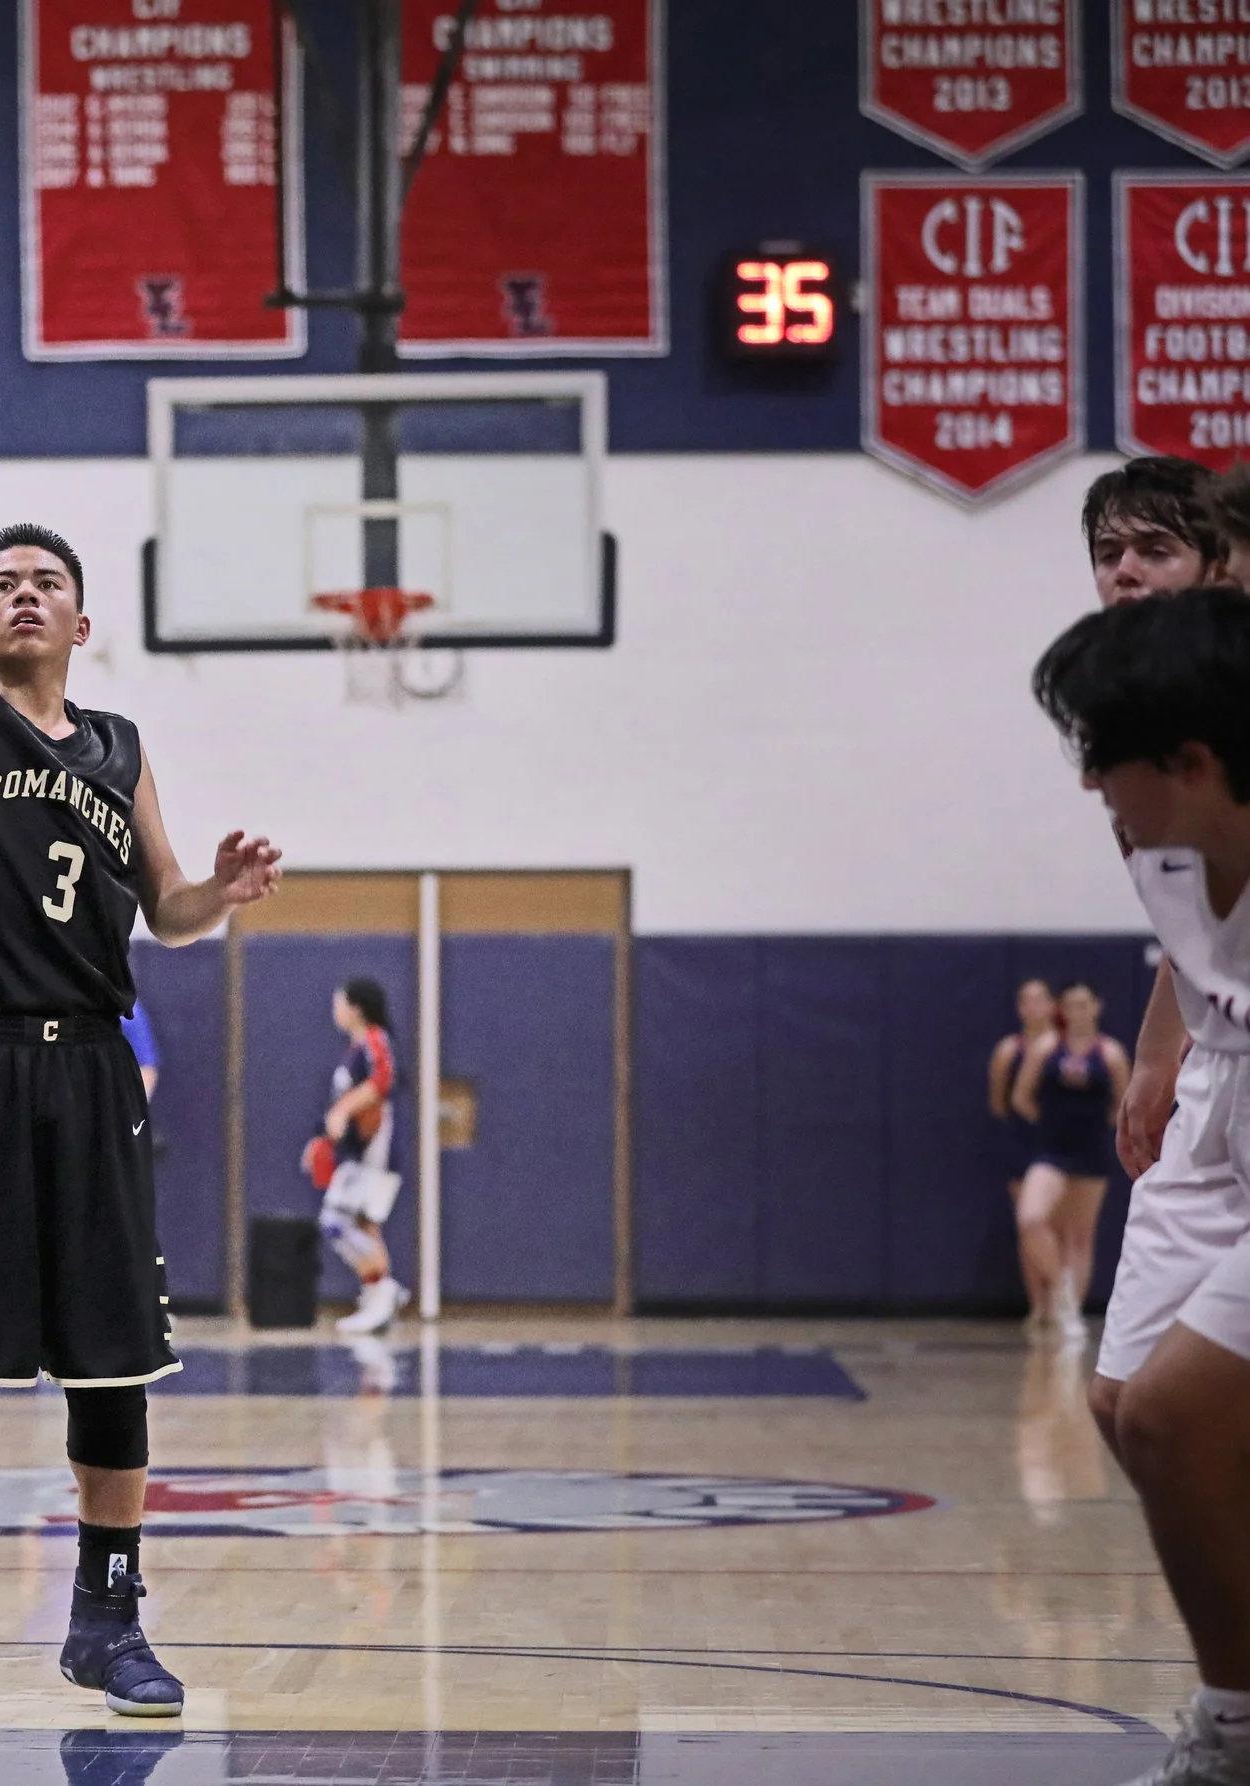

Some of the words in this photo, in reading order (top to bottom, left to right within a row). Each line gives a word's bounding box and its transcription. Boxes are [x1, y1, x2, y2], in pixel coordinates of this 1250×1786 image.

[881, 0, 1060, 25] WRESTLING
[71, 22, 251, 60] CHAMPIONS
[881, 34, 1060, 69] CHAMPIONS
[91, 63, 233, 91] WRESTLING
[933, 75, 1011, 112] 2013
[921, 195, 1025, 278] CIF
[736, 261, 834, 344] 35
[896, 285, 961, 321] TEAM
[967, 285, 1053, 320] DUALS
[884, 325, 1065, 363] WRESTLING
[883, 366, 1064, 406] CHAMPIONS
[935, 411, 1013, 449] 2014
[42, 840, 85, 923] 3
[43, 1021, 58, 1041] C
